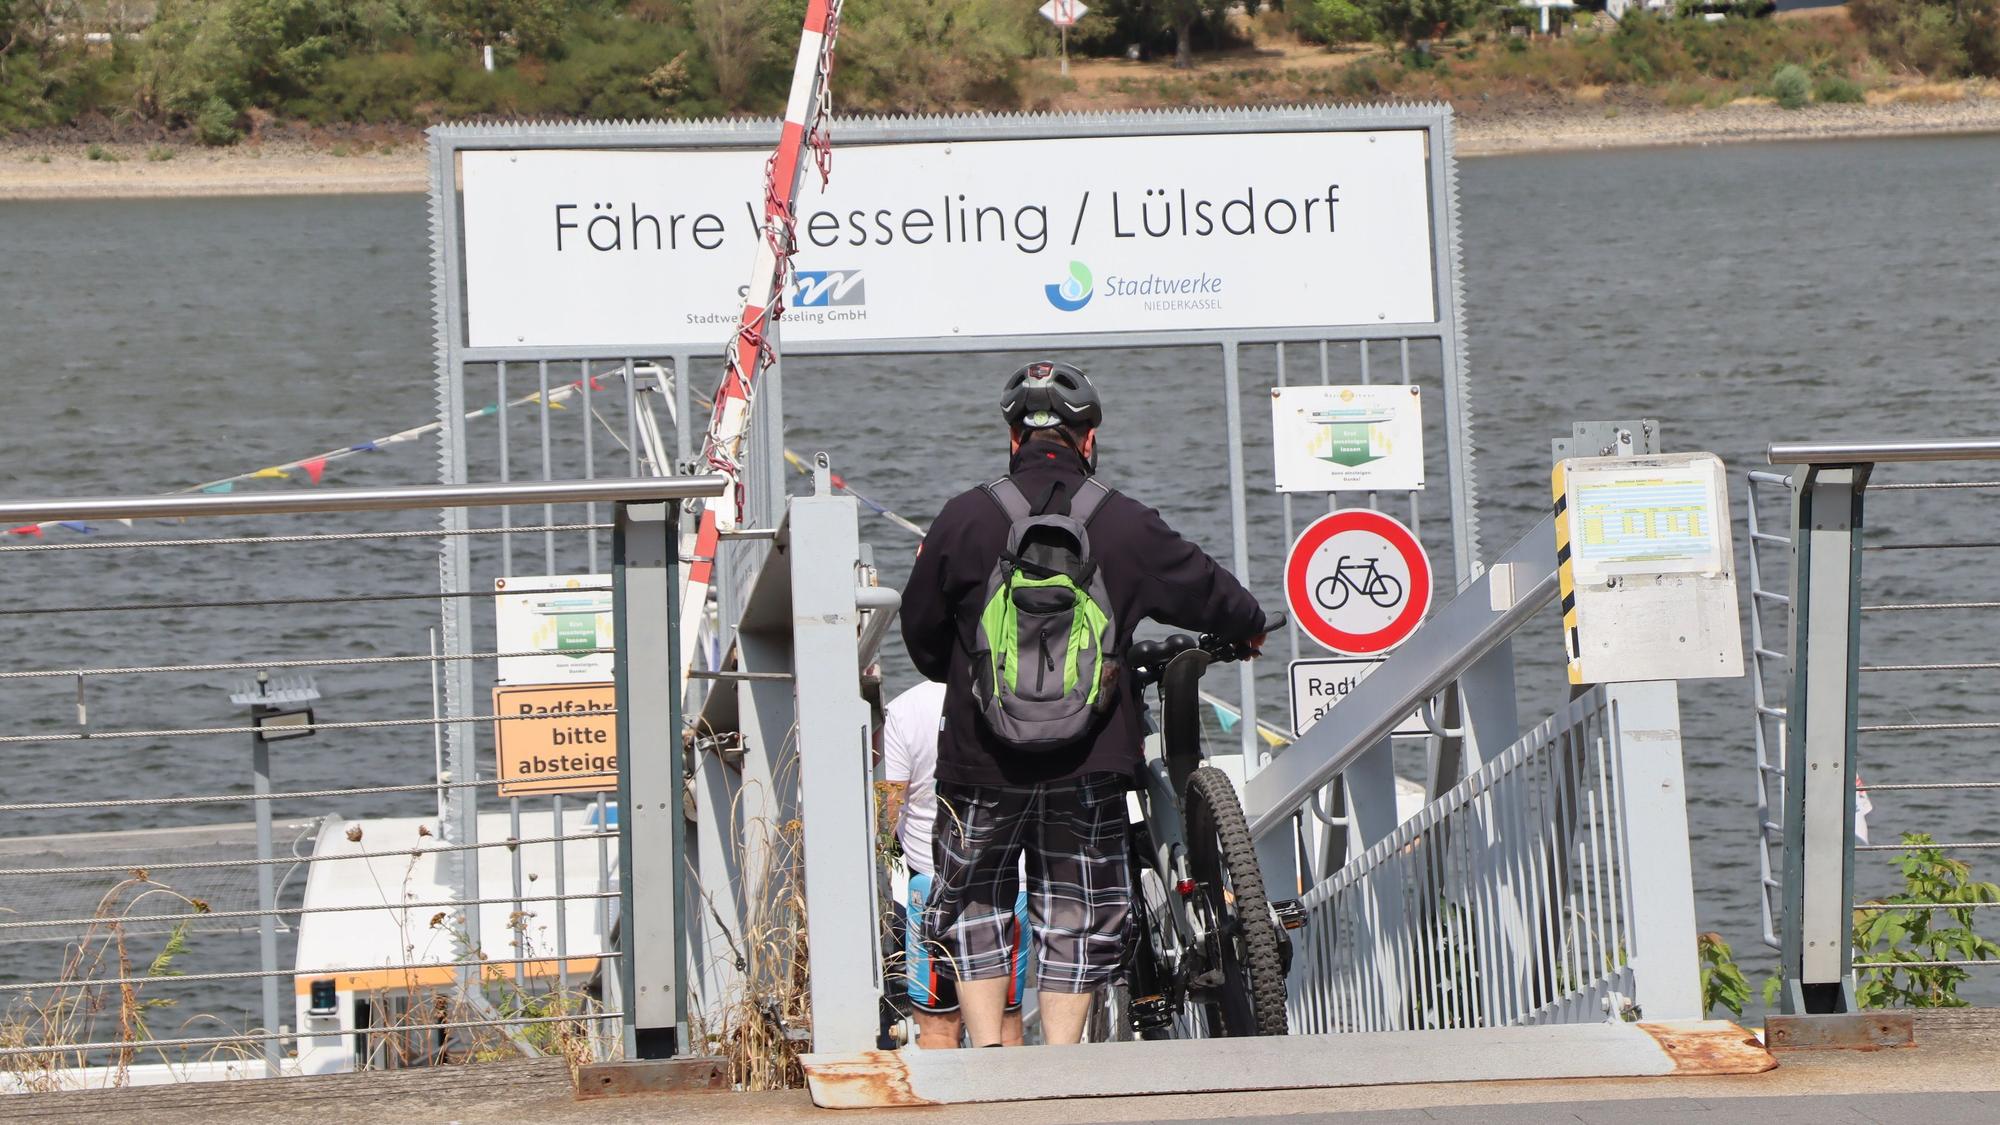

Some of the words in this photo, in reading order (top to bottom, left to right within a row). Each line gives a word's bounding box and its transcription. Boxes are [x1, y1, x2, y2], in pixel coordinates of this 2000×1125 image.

[556, 202, 725, 251] Fähre
[1071, 191, 1090, 246] /
[1112, 184, 1340, 238] Lülsdorf
[1104, 272, 1223, 297] Stadtwerke
[1144, 298, 1223, 312] NIEDERKASSEL
[686, 313, 741, 324] Stadtwe
[780, 312, 824, 324] sseling
[827, 310, 867, 321] GmbH
[519, 699, 613, 720] Radfahr
[552, 727, 607, 746] bitte
[519, 753, 617, 775] absteige
